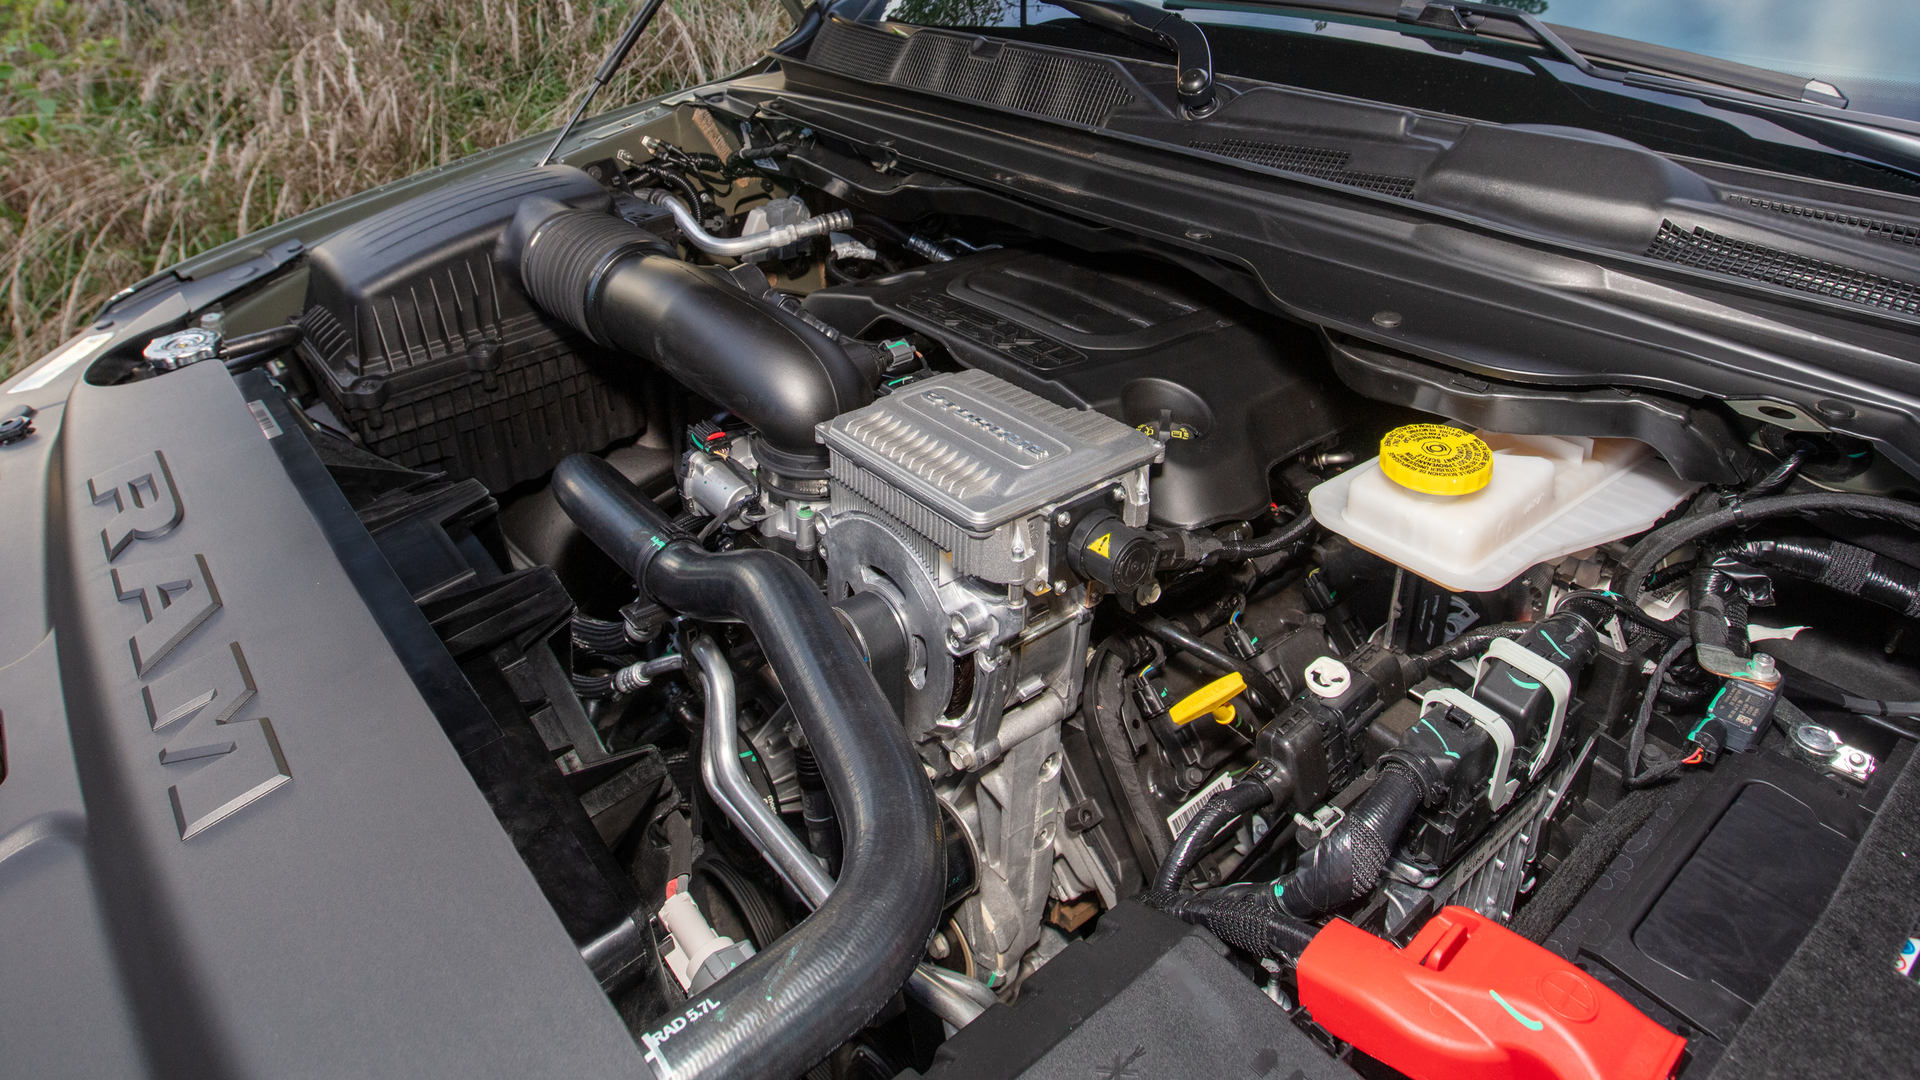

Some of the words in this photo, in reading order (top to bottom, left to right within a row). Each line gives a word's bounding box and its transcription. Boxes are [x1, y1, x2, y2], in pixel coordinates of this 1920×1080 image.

[87, 450, 293, 842] RAM
[650, 1016, 687, 1042] RAD
[685, 998, 721, 1023] 5.7L
